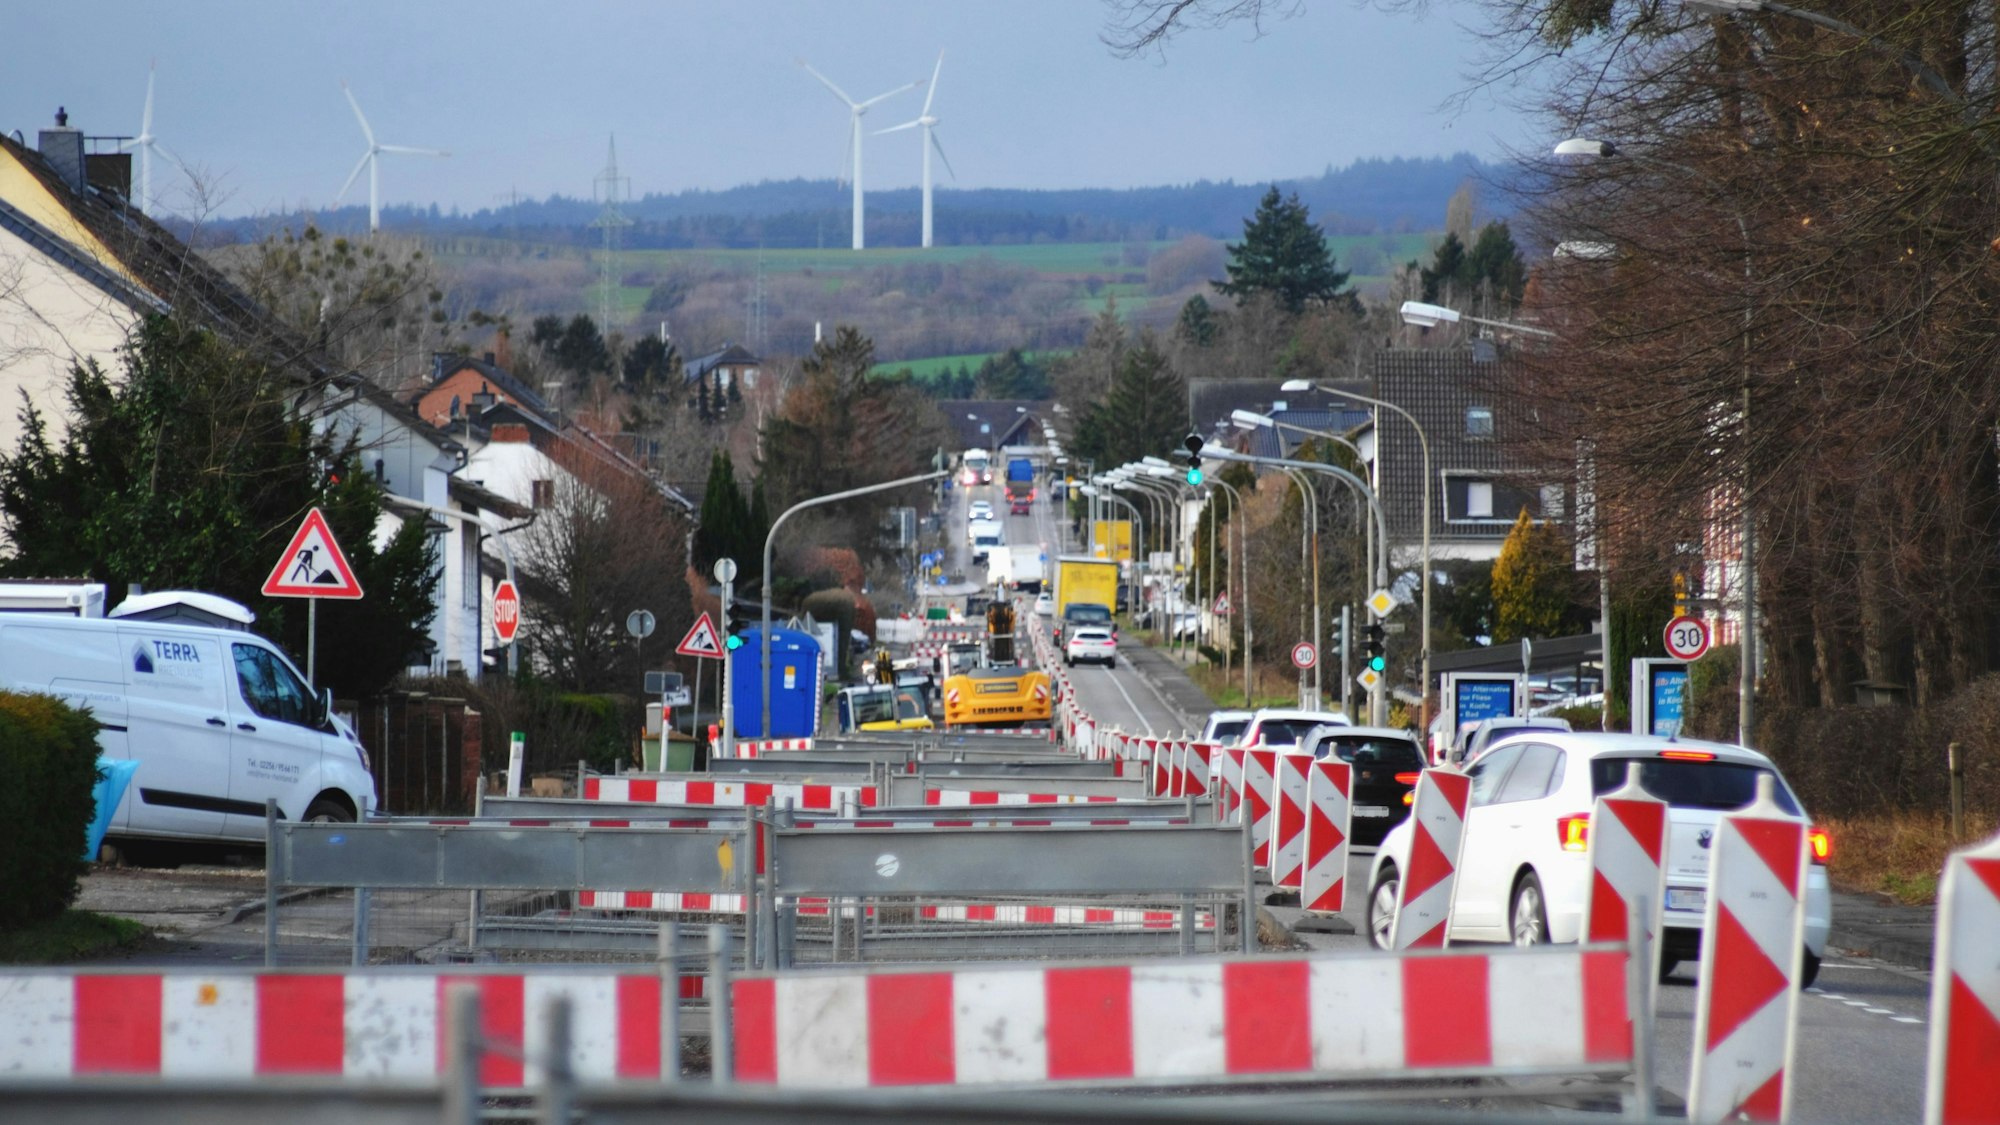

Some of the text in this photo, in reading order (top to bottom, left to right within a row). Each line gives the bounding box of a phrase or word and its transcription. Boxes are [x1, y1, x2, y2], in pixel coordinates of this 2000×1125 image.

[495, 600, 516, 623] STOP
[1674, 628, 1700, 648] 30
[152, 640, 200, 663] TERRA
[1297, 650, 1311, 661] 30
[1472, 685, 1511, 693] Alternative
[1465, 710, 1479, 718] Bad
